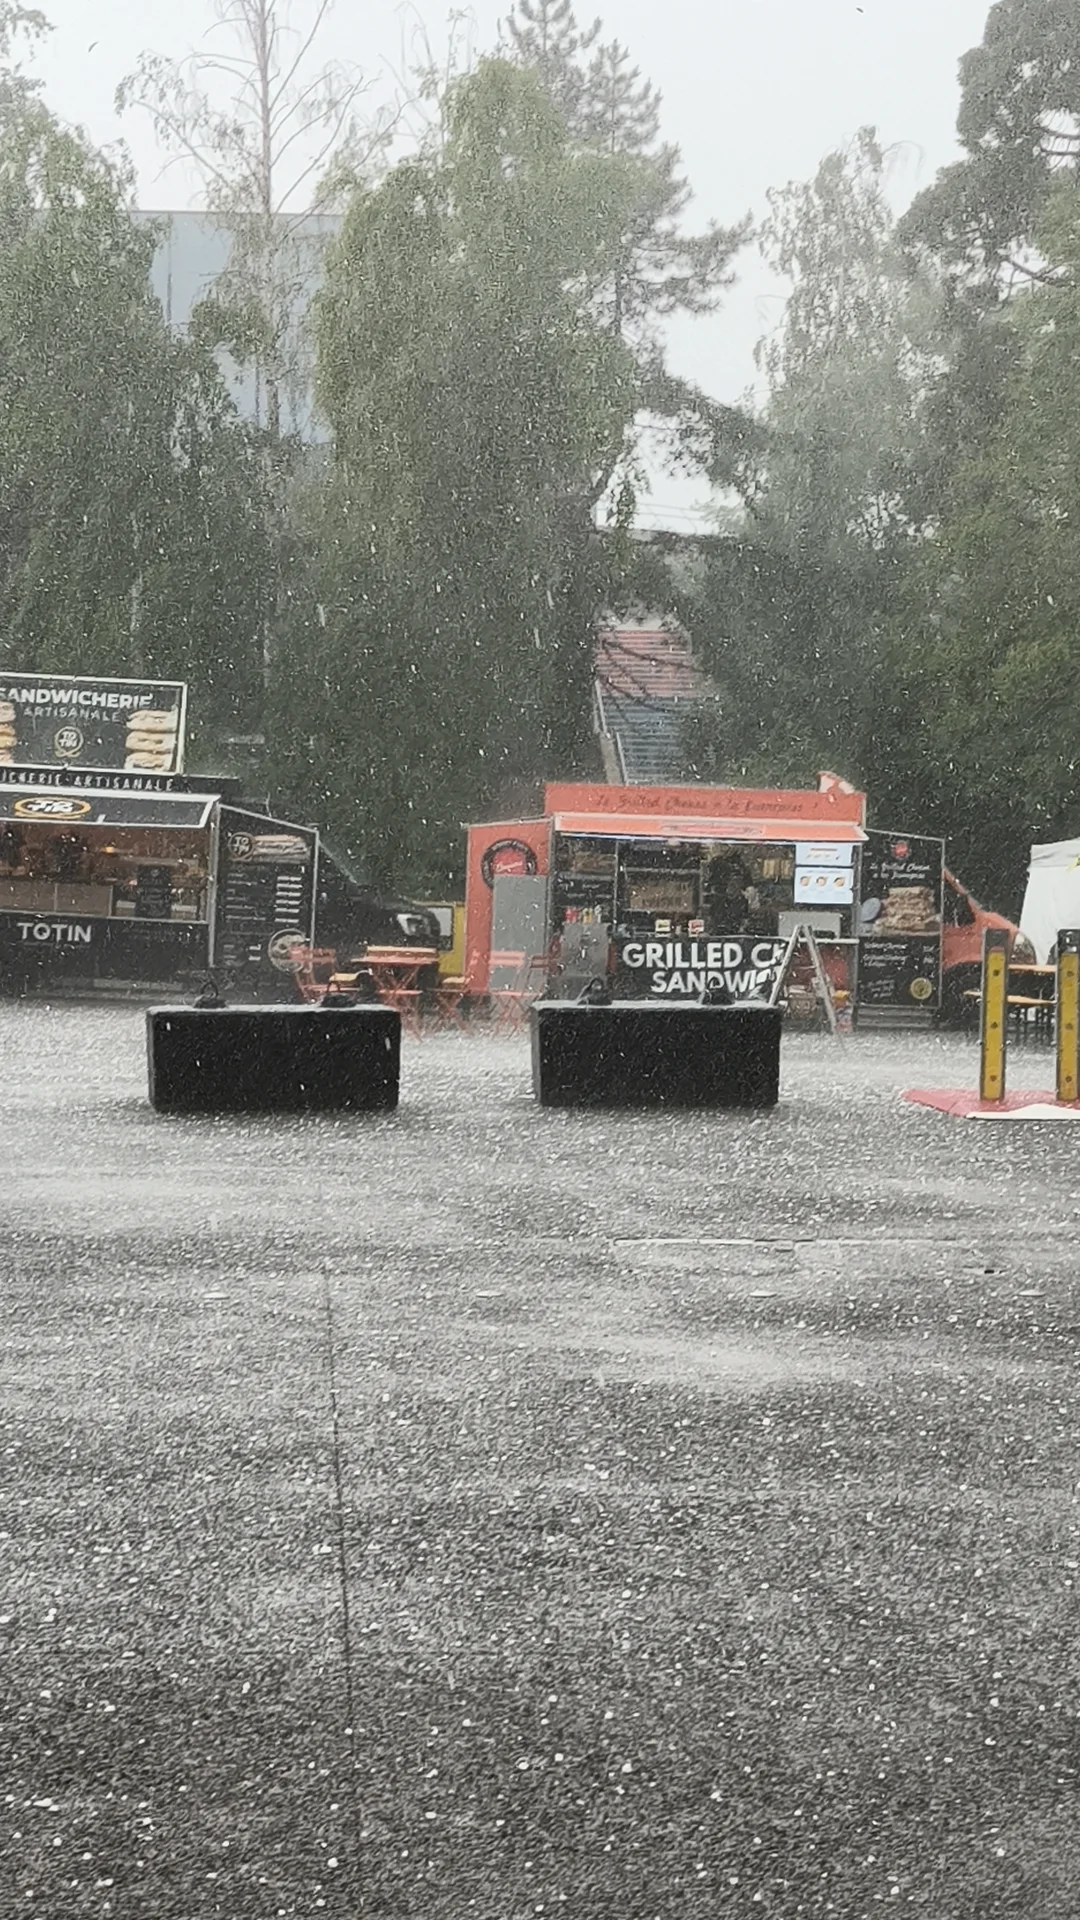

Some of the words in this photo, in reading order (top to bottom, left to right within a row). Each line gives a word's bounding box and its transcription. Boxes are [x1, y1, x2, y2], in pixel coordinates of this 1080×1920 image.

[24, 707, 121, 722] ARTISANALE
[73, 775, 174, 793] ARTISANALE
[16, 922, 92, 943] TOTIN
[622, 942, 743, 969] GRILLED
